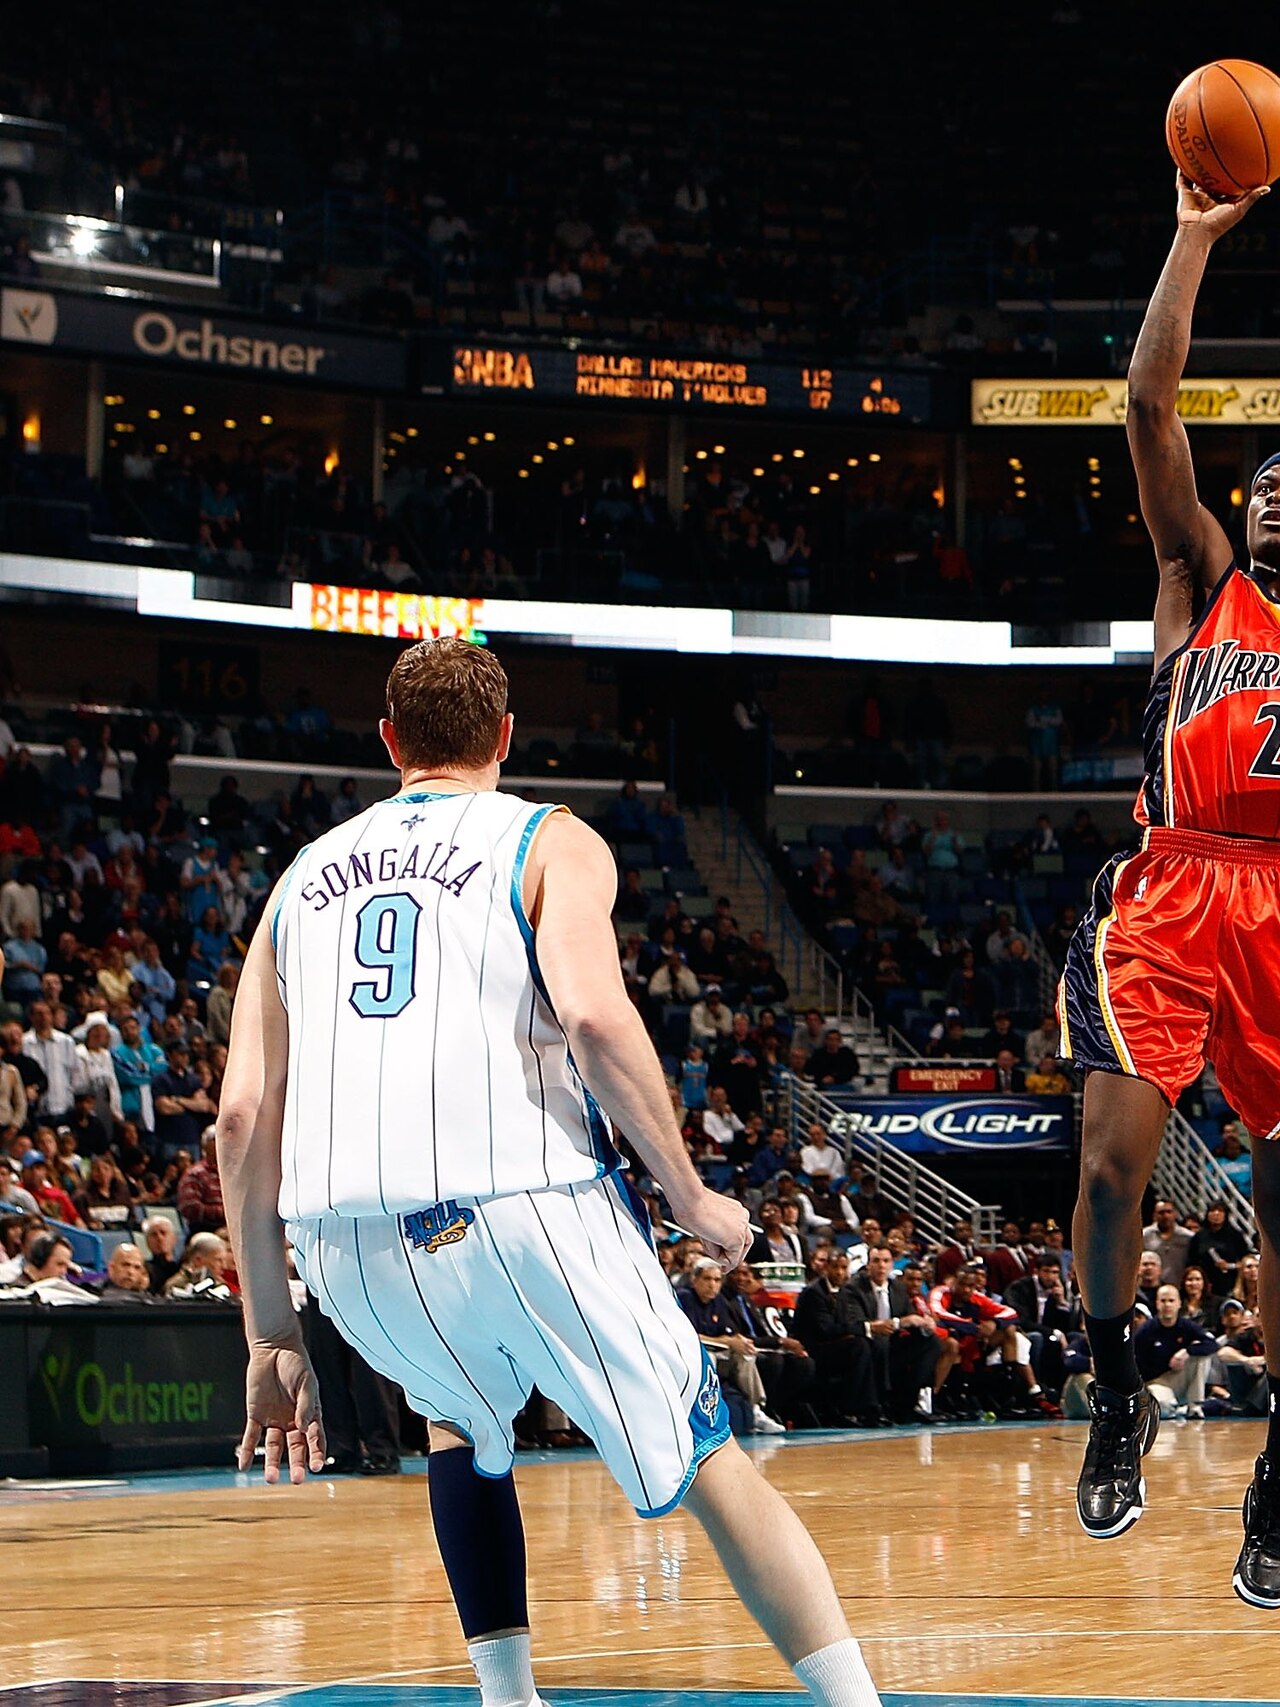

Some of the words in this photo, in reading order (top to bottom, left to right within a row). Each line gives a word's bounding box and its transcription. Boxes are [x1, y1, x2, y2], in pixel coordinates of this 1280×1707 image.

[133, 312, 325, 375] Ochsner
[575, 353, 644, 376] DALLAS
[649, 357, 748, 384] MAVERICKS
[801, 369, 833, 389] 112
[575, 374, 676, 401] MINNESOTA
[980, 385, 1110, 420] SUBWAY
[300, 842, 483, 912] SONGAILA
[348, 892, 424, 1019] 9
[909, 1068, 984, 1082] EMERGENCY
[932, 1081, 960, 1092] EXIT
[940, 1113, 1063, 1134] LIGHT
[76, 1361, 215, 1427] Ochsner
